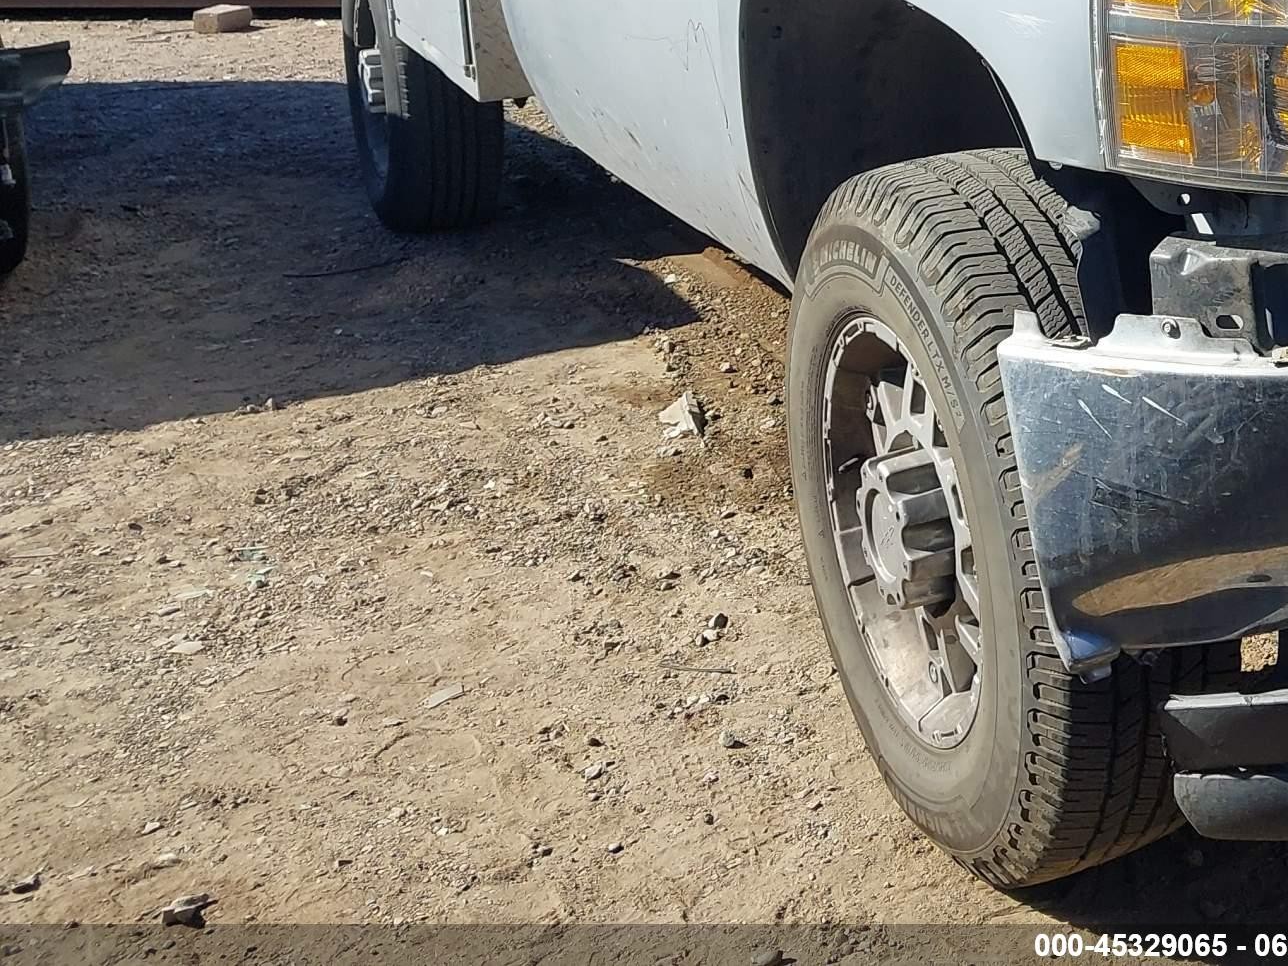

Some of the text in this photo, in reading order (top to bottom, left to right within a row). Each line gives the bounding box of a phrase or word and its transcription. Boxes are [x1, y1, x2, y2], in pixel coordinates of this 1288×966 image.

[819, 240, 878, 275] MICHELIN
[889, 275, 929, 340] DEFENDER
[927, 340, 945, 372] LTX
